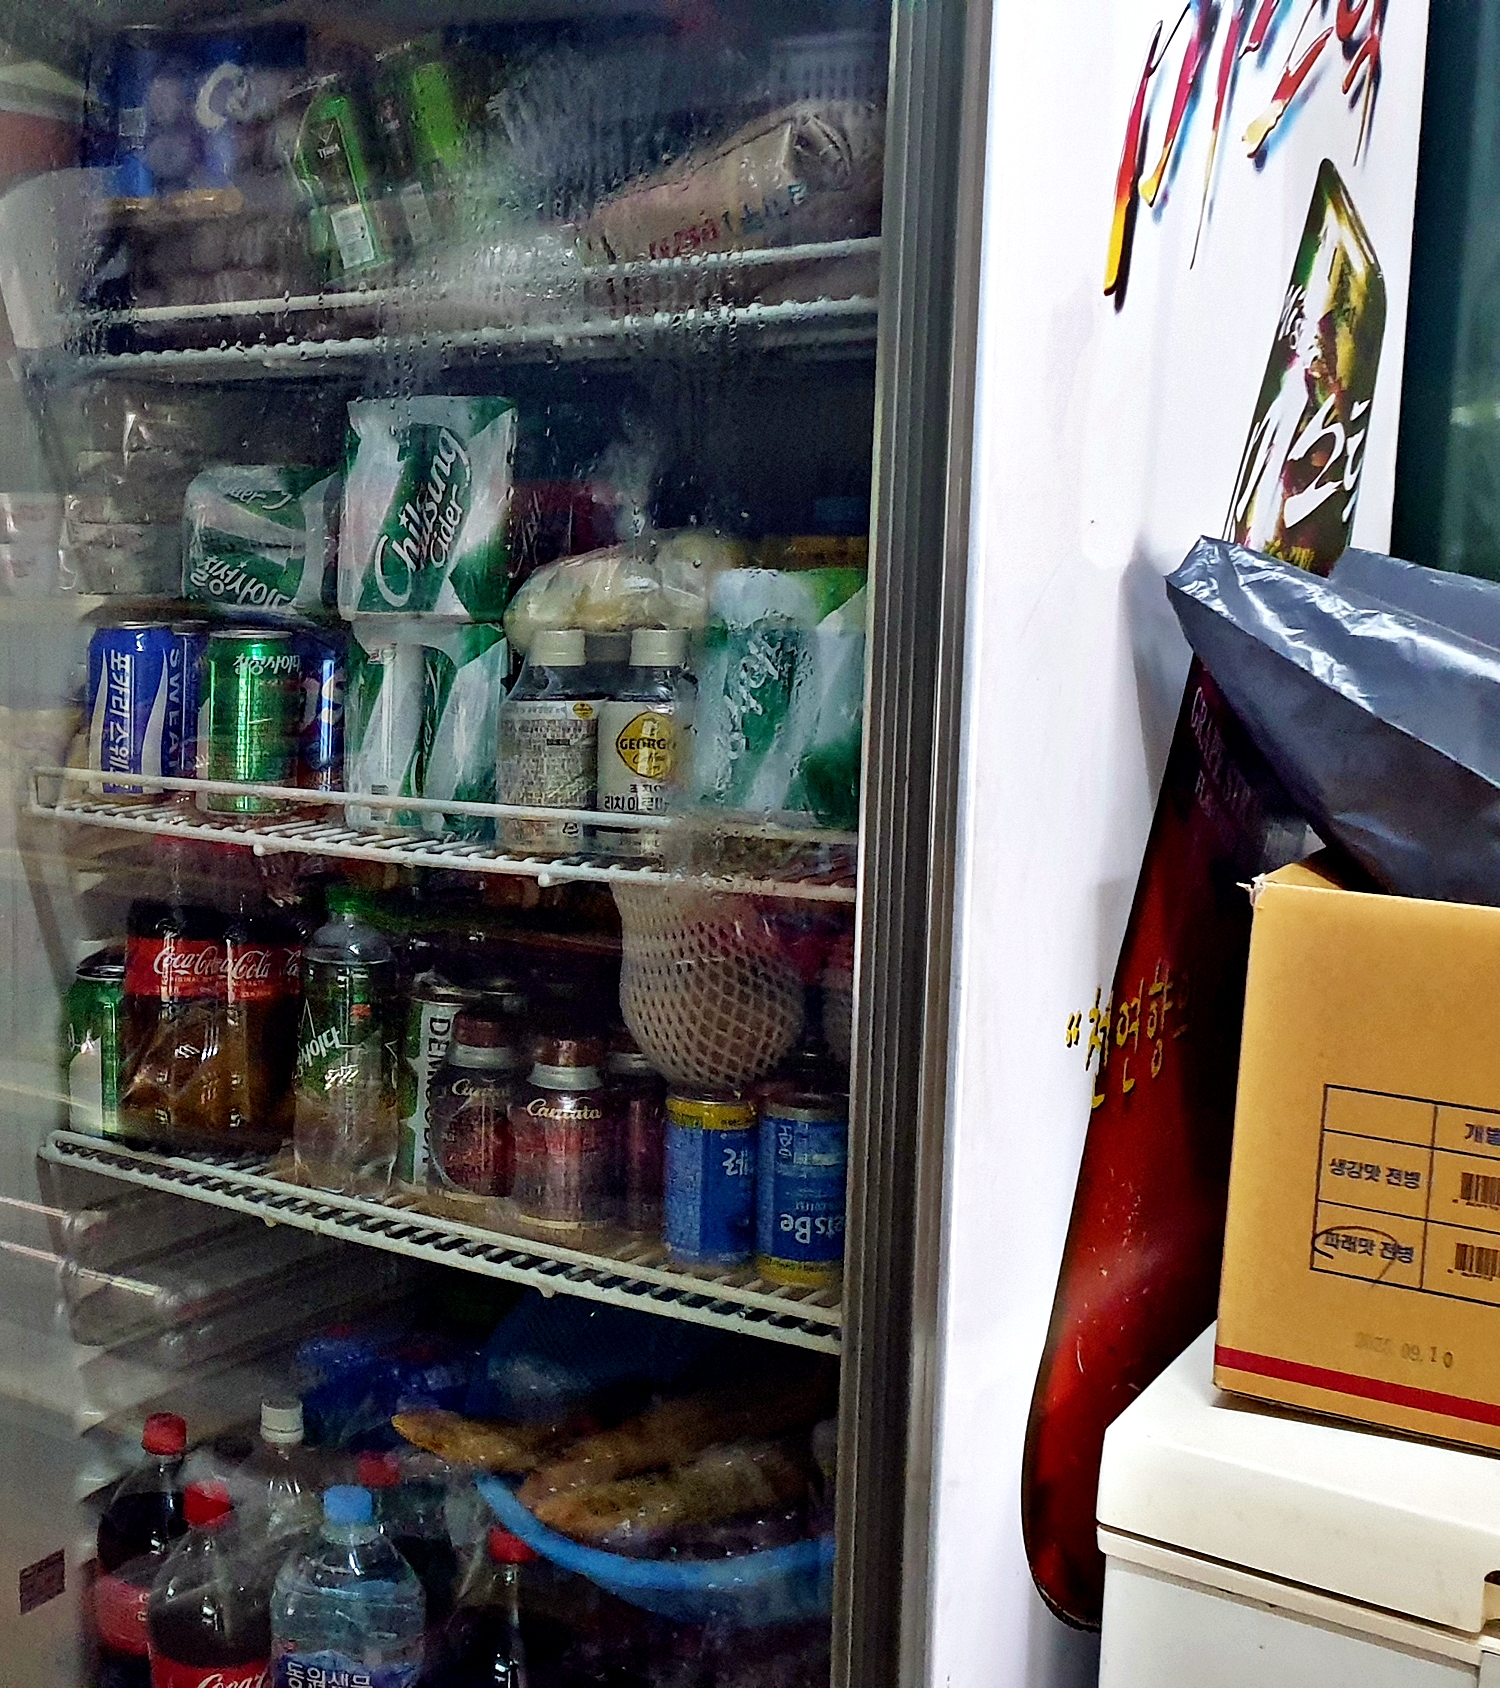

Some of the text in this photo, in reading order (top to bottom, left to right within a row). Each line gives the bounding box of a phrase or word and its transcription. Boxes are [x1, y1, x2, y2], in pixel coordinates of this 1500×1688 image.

[429, 484, 463, 569] Cider
[619, 738, 668, 751] GEORG
[1329, 1157, 1422, 1190] 생강맛 전병
[1323, 1230, 1415, 1264] 파래맛 전병
